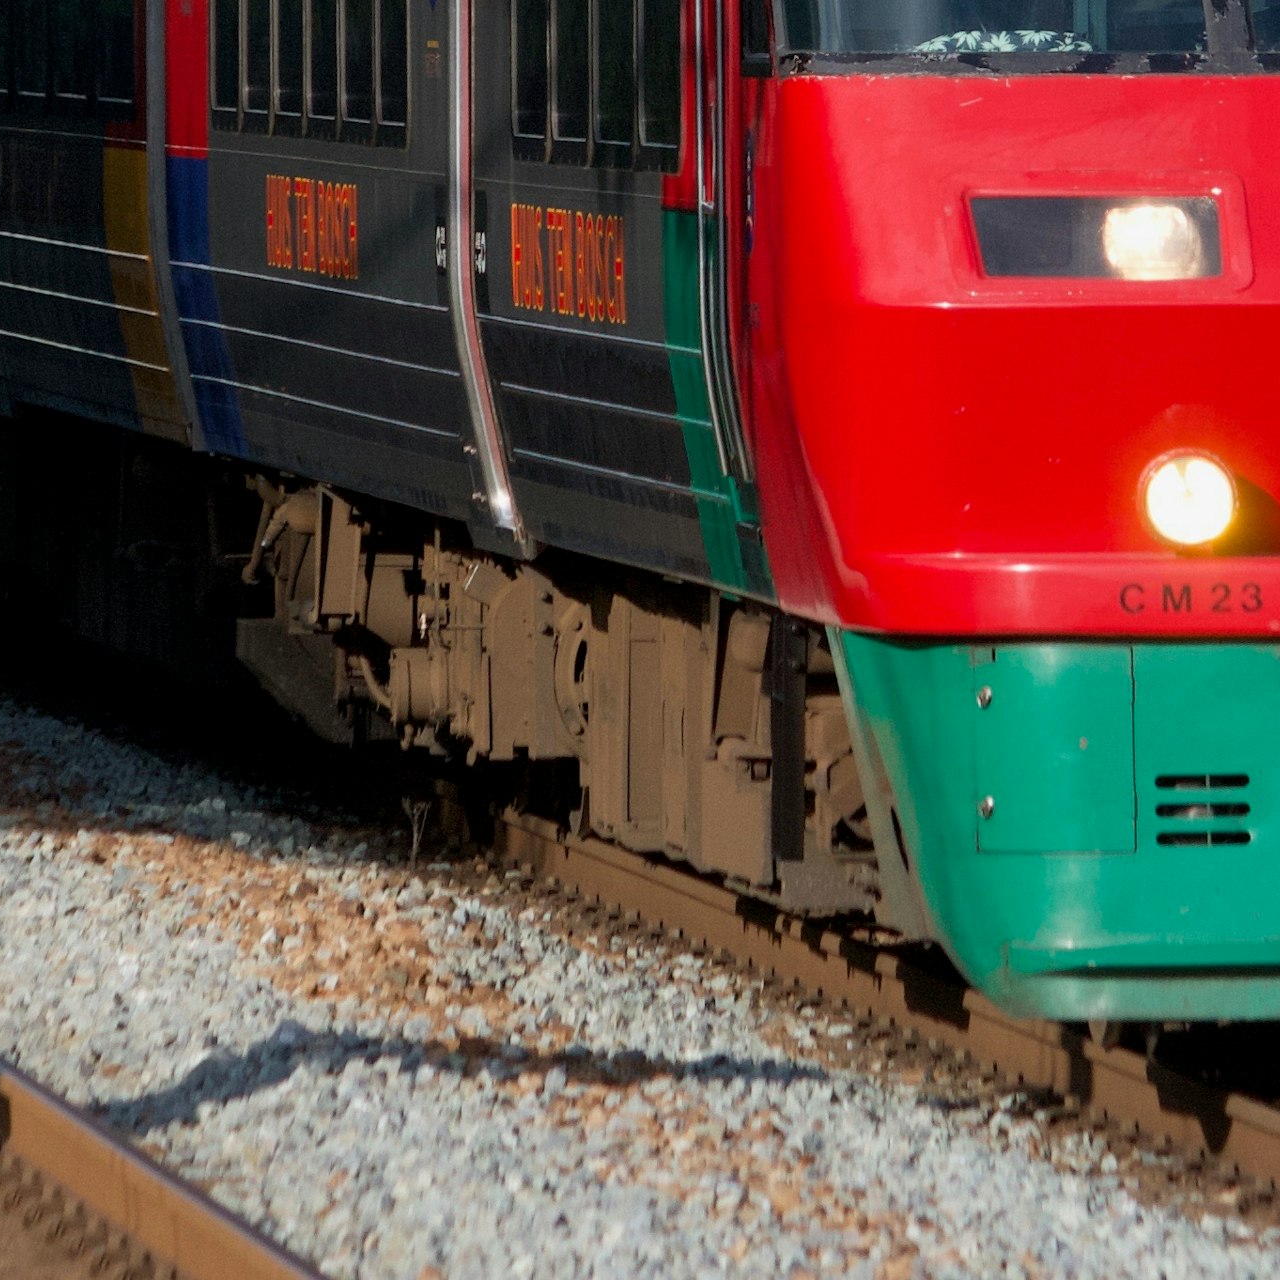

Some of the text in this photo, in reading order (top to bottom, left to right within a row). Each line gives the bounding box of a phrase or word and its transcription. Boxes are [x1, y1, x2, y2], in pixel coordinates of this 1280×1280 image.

[266, 173, 359, 280] HUIS TEN BOSCH
[510, 202, 626, 325] HUIS TEN BOSCH
